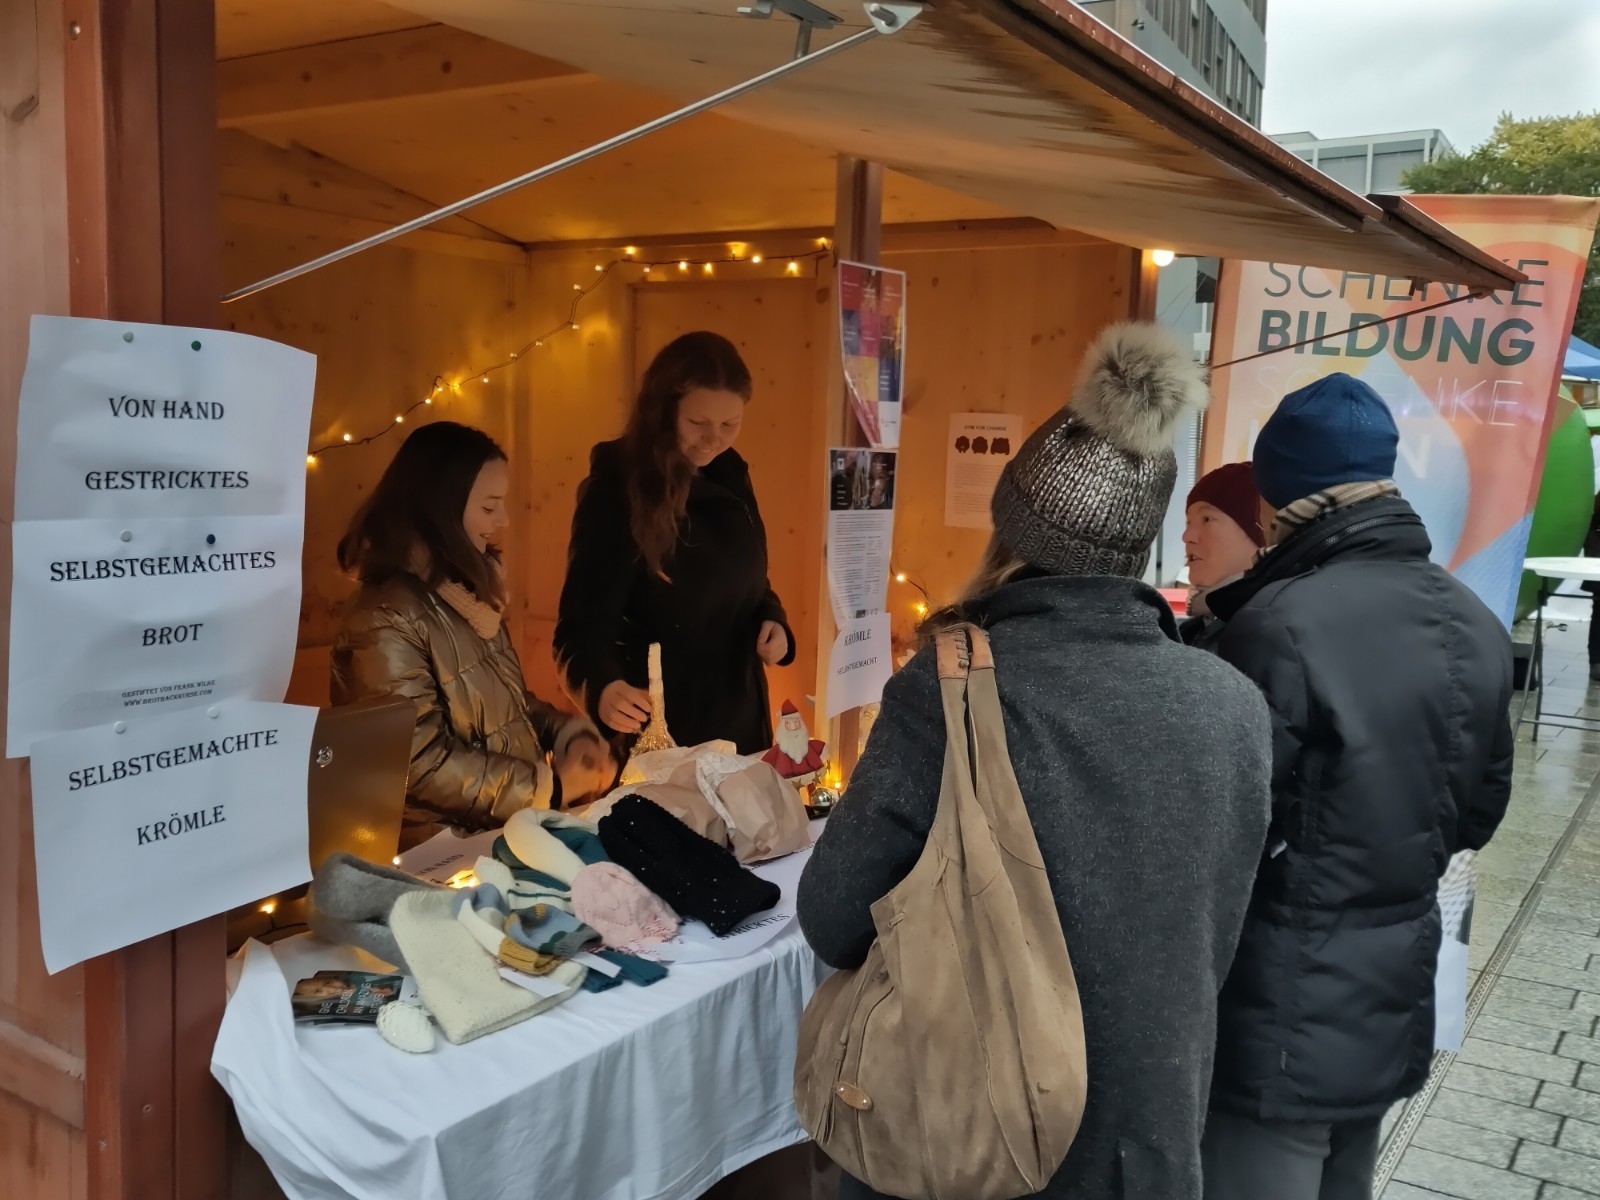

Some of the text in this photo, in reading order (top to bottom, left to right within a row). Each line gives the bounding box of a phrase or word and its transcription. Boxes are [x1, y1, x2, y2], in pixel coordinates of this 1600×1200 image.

[1258, 309, 1535, 366] BILDUNG
[108, 395, 224, 420] VON HAND
[85, 471, 249, 490] GESTRICKTES
[50, 551, 276, 581] SELBSTGEMACHTES
[142, 624, 203, 646] BROT
[837, 657, 878, 675] SELBSTGEMACHT
[122, 680, 215, 698] GESTIFTET VON FRANK WILKE
[69, 729, 278, 791] SELBSTGEMACHTE
[137, 805, 226, 846] KRÖMLE
